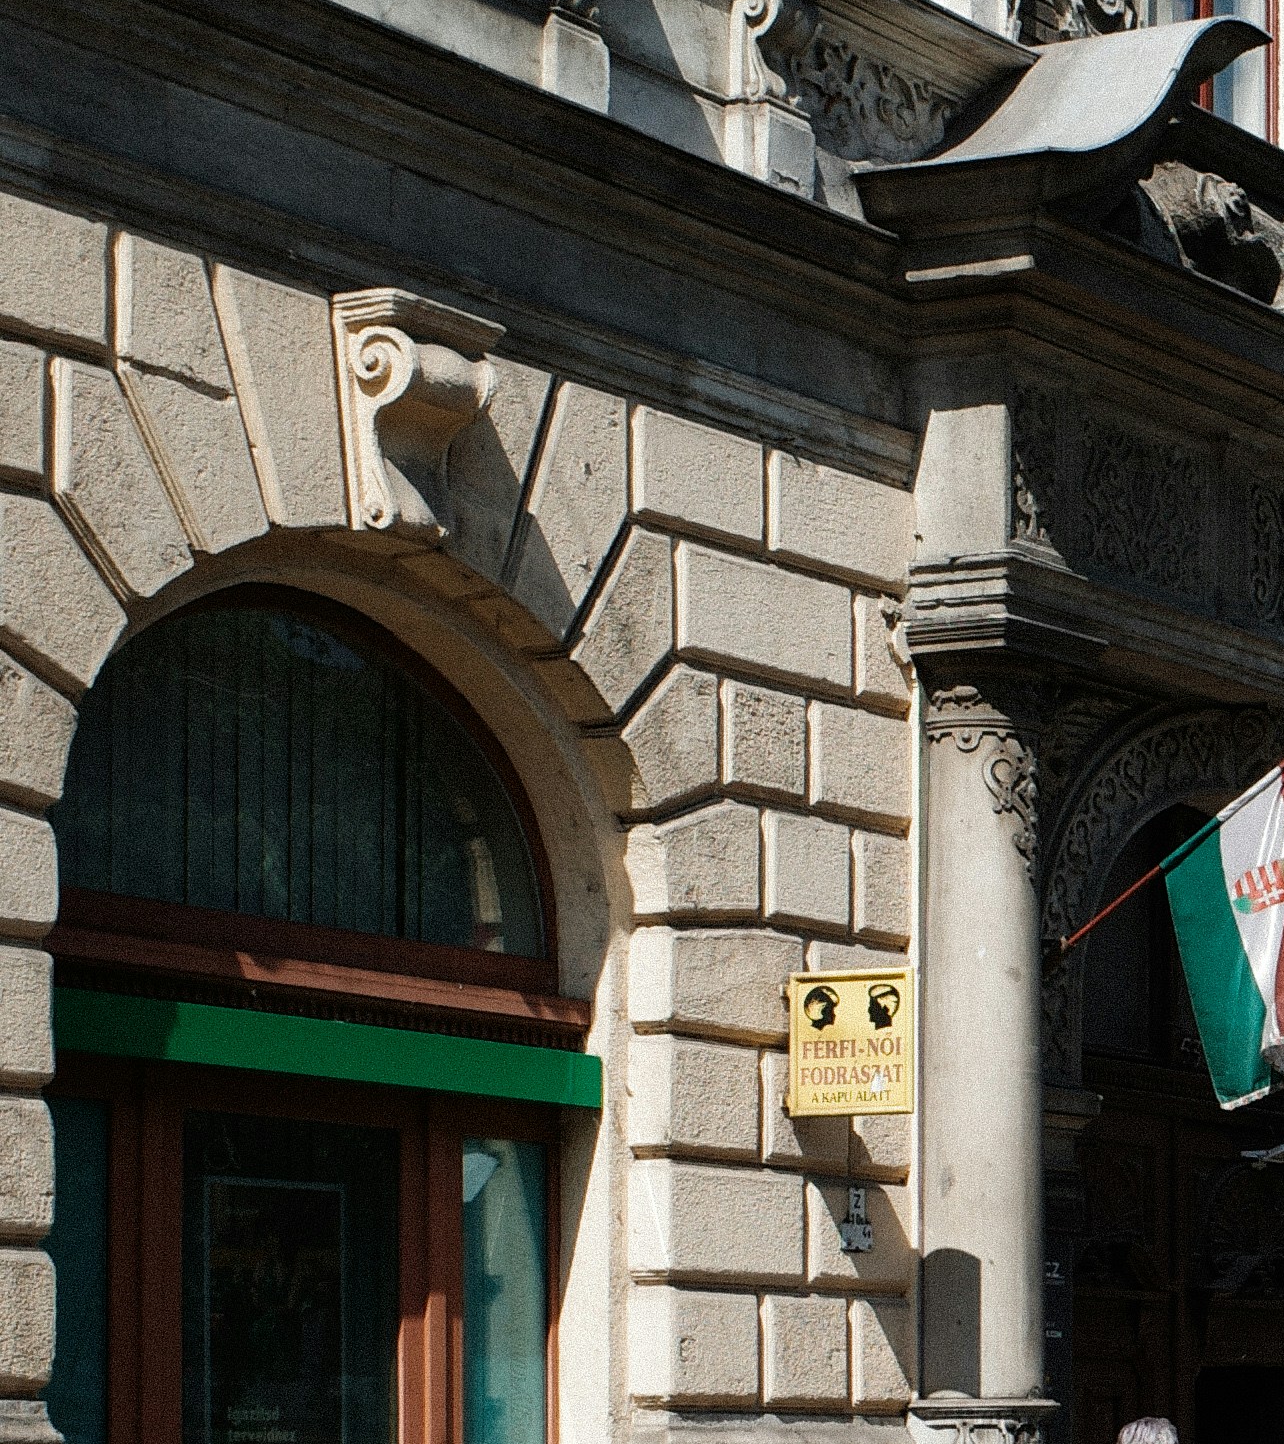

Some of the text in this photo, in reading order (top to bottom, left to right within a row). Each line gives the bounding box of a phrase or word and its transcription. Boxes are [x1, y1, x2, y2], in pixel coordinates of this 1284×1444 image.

[811, 1089, 891, 1103] A KAPU ALATT
